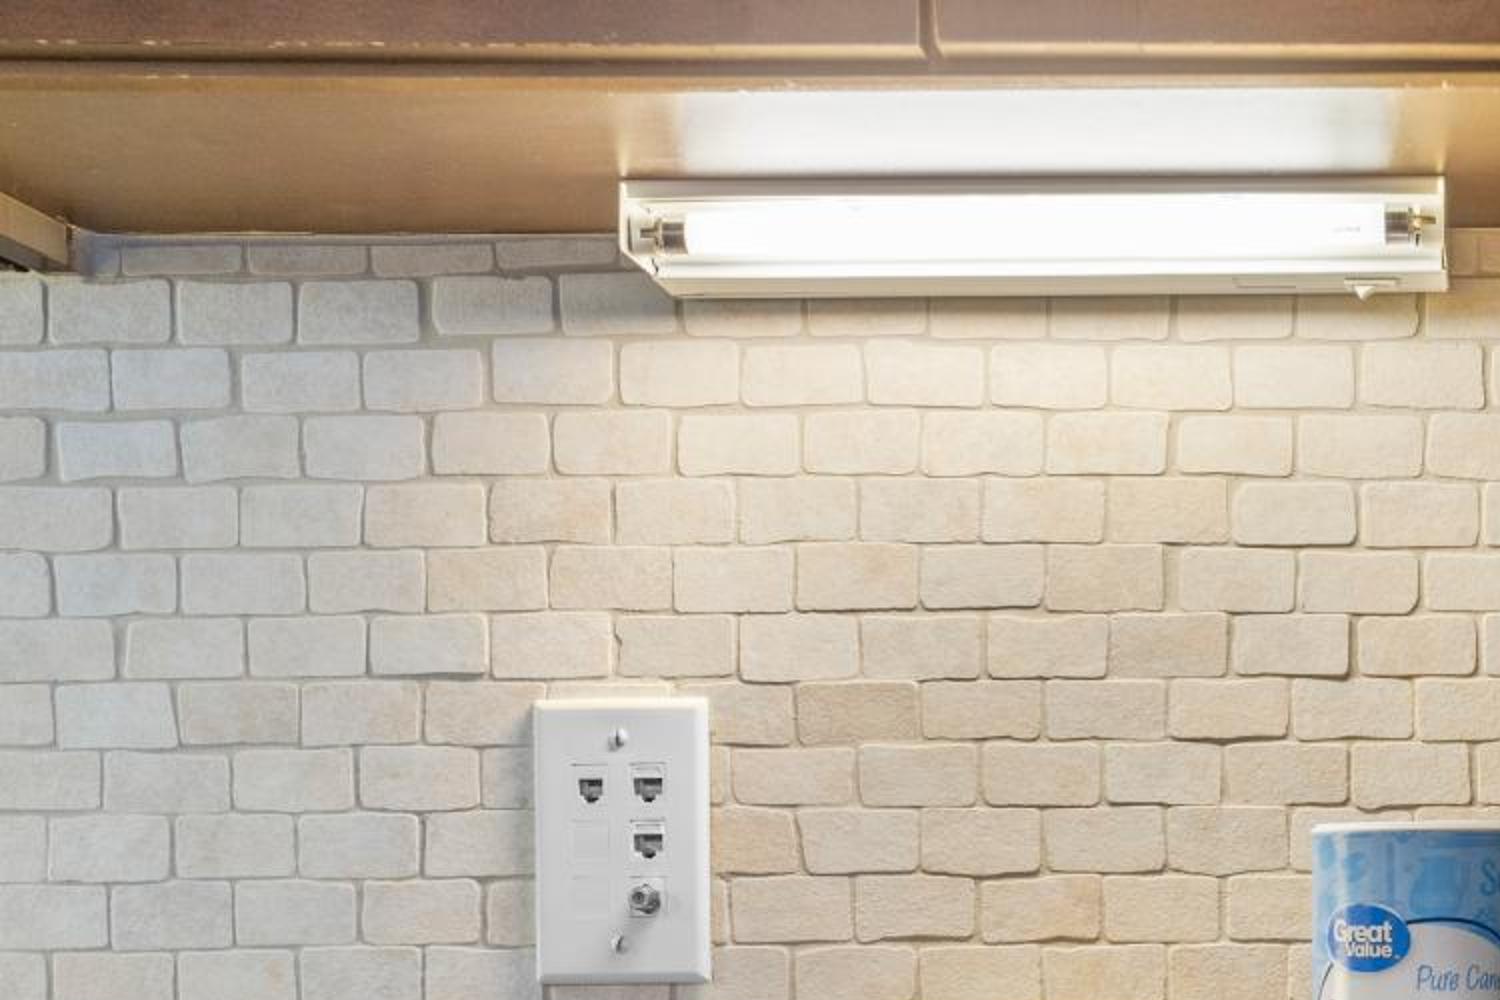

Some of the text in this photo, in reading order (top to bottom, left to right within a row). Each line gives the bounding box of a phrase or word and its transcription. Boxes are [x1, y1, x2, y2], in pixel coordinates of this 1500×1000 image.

[1333, 919, 1392, 943] Great
[1344, 942, 1393, 958] Value
[1417, 964, 1459, 991] Pure
